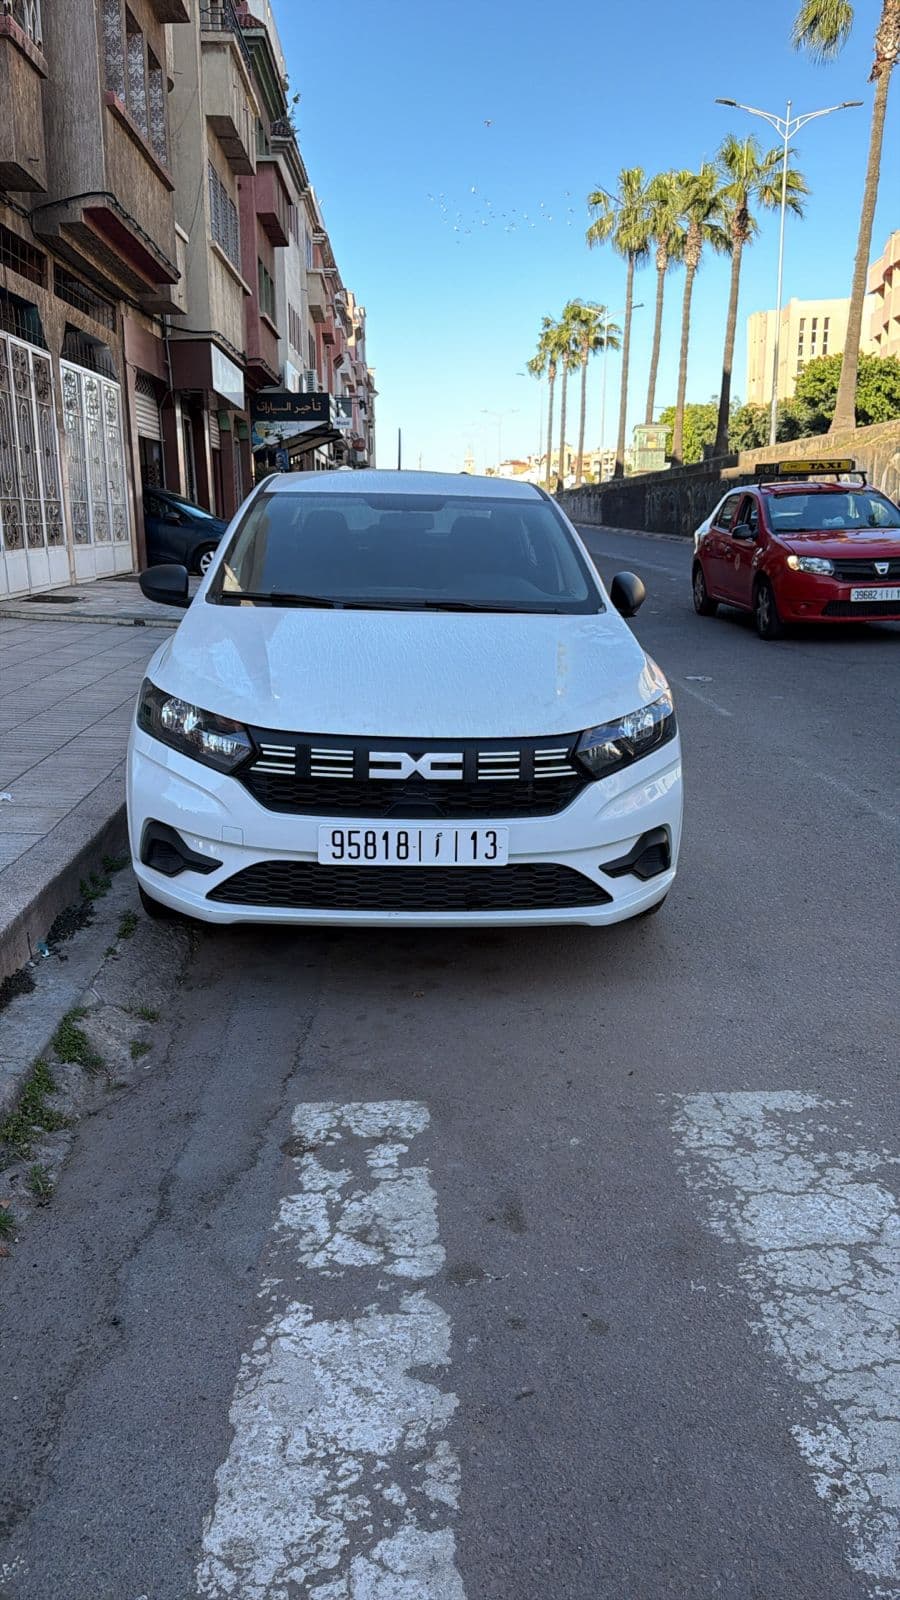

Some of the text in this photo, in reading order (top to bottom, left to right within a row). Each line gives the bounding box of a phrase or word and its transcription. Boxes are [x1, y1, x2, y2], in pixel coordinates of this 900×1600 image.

[808, 462, 842, 470] TAXI
[331, 830, 498, 860] 95818 أ 13
